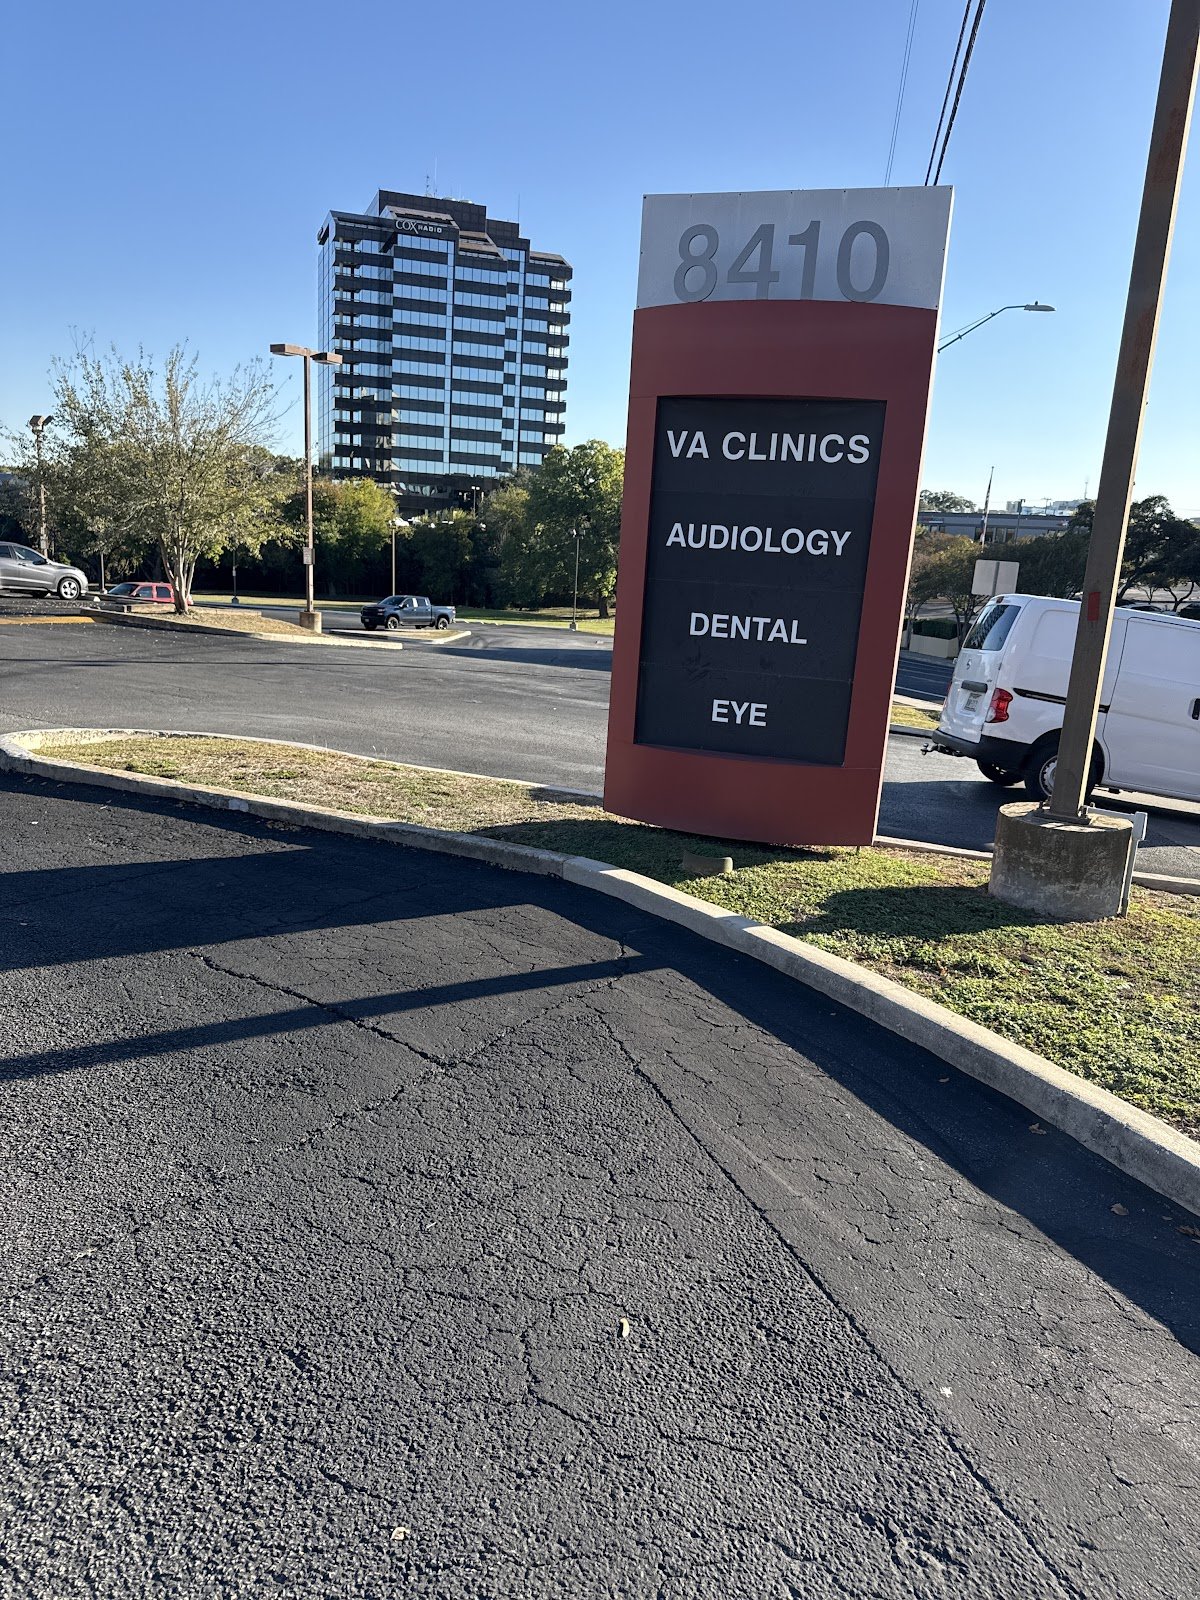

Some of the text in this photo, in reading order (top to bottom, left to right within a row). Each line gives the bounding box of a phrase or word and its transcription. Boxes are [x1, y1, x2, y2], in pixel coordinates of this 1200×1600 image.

[395, 220, 442, 234] COX RADIO
[673, 220, 890, 303] 8410
[666, 430, 871, 464] VA CLINICS
[665, 522, 851, 556] AUDIOLOGY
[689, 612, 807, 645] DENTAL
[711, 699, 768, 727] EYE
